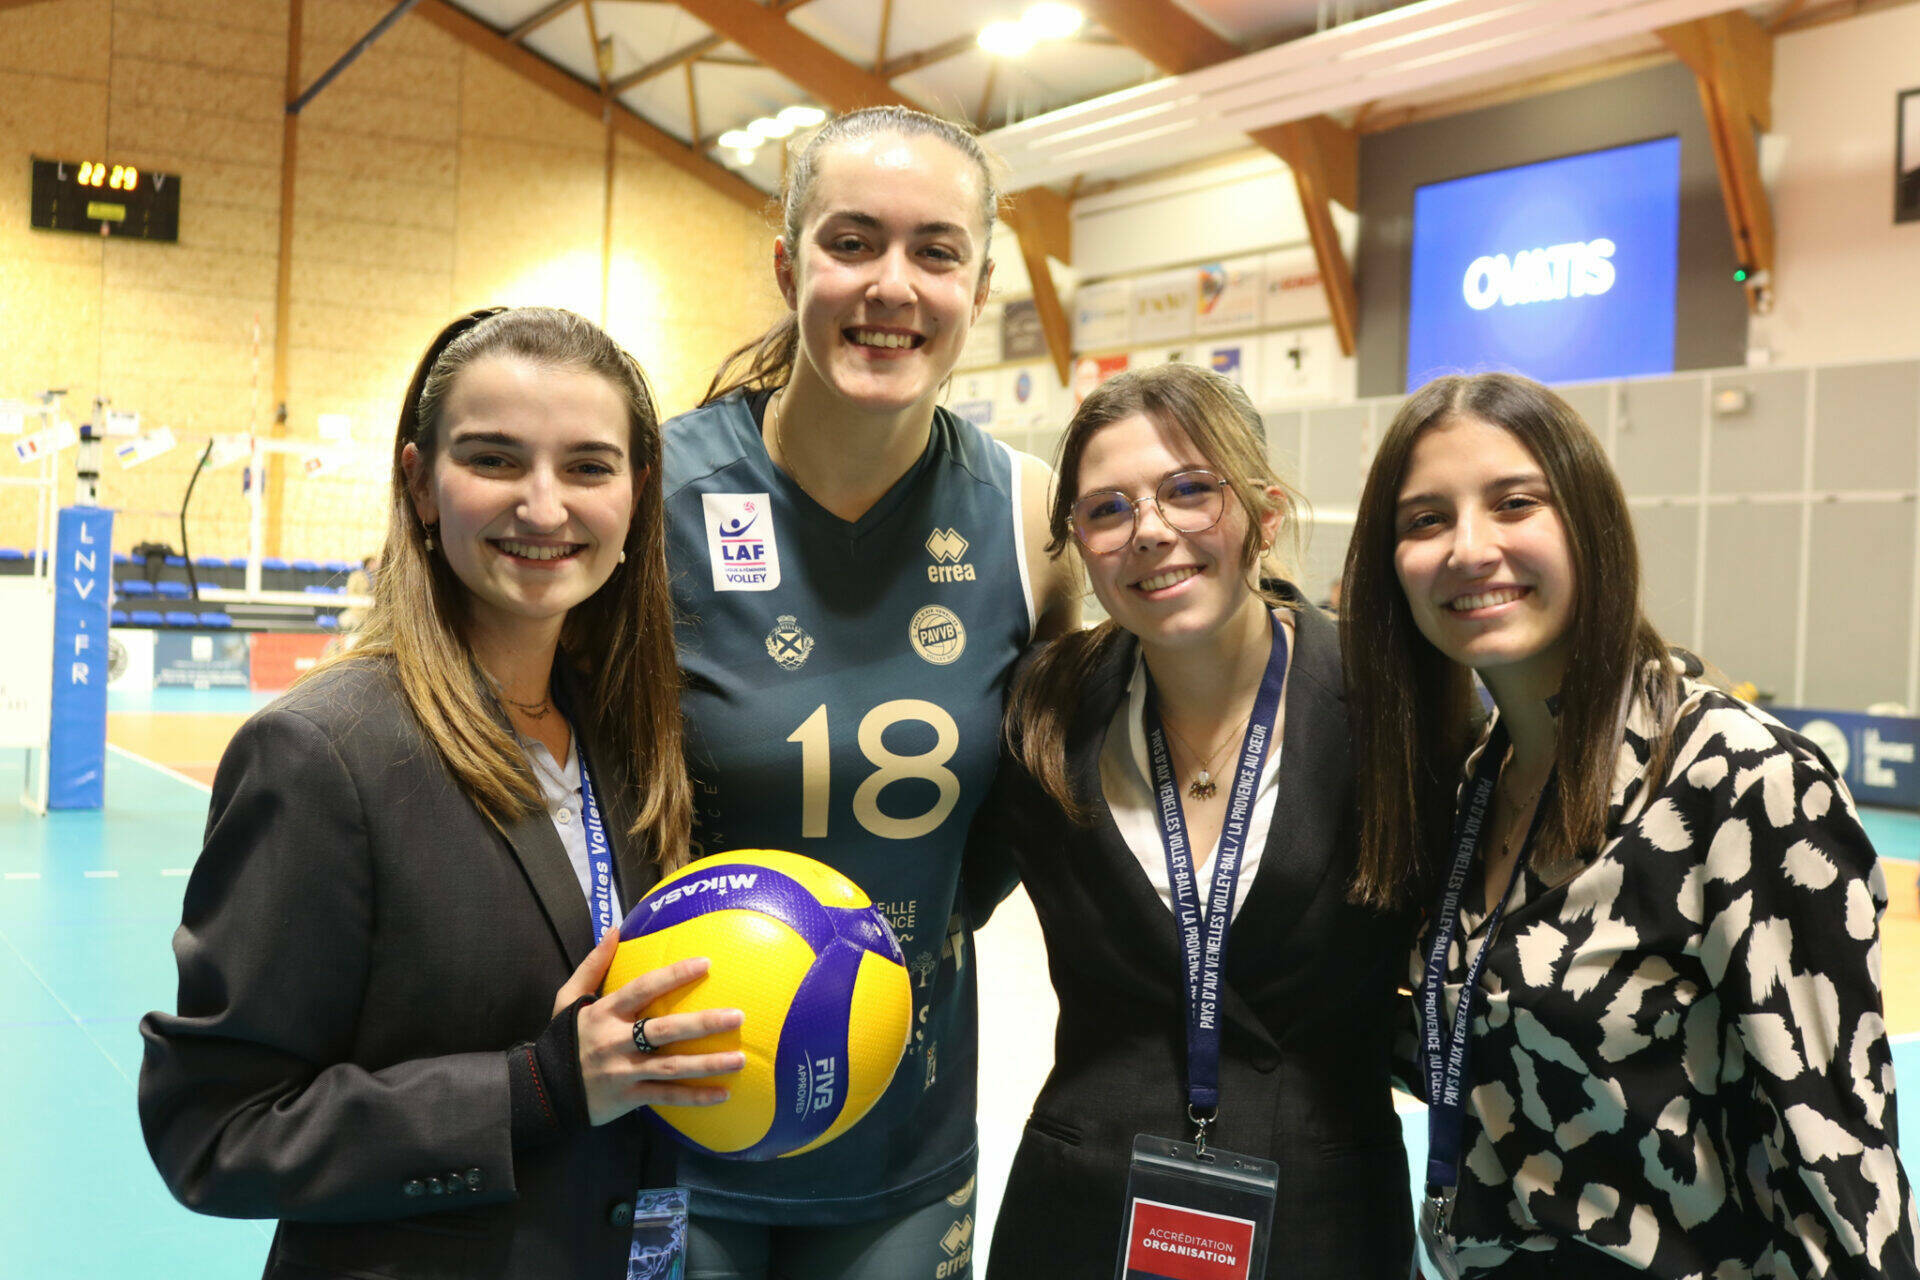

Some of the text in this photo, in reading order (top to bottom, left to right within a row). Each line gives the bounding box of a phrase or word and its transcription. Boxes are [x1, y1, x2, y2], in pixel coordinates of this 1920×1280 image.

[722, 545, 765, 560] LAF
[727, 573, 767, 583] VOLLEY
[927, 563, 976, 583] errea
[920, 624, 956, 645] PAVVB
[1248, 723, 1267, 755] CŒUR
[786, 698, 961, 840] 18
[1244, 756, 1259, 770] AU
[1159, 780, 1181, 832] VENELLES
[1231, 768, 1256, 821] PROVENCE
[1228, 822, 1243, 836] LA
[1168, 831, 1193, 900] VOLLEY-BALL
[1448, 836, 1476, 890] VENELLES
[650, 874, 758, 912] MIKASA
[1212, 845, 1239, 913] VOLLEY-BALL
[597, 861, 611, 942] enelles
[1181, 910, 1196, 925] LA
[1430, 891, 1459, 963] VOLLEY-BALL
[1205, 914, 1225, 969] VENELLES
[1202, 970, 1218, 1001] D'AIX
[1426, 975, 1439, 989] LA
[1200, 1001, 1216, 1030] PAYS
[1425, 991, 1440, 1051] PROVENCE
[1453, 988, 1471, 1044] VENELLES
[1429, 1054, 1443, 1069] AU
[1449, 1046, 1464, 1077] D'AIX
[795, 1064, 807, 1114] APPROVED
[814, 1056, 835, 1111] FIVB
[1444, 1076, 1459, 1106] PAYS
[1143, 1238, 1236, 1266] ORGANISATION
[1149, 1227, 1233, 1252] ACCRÉDITATION
